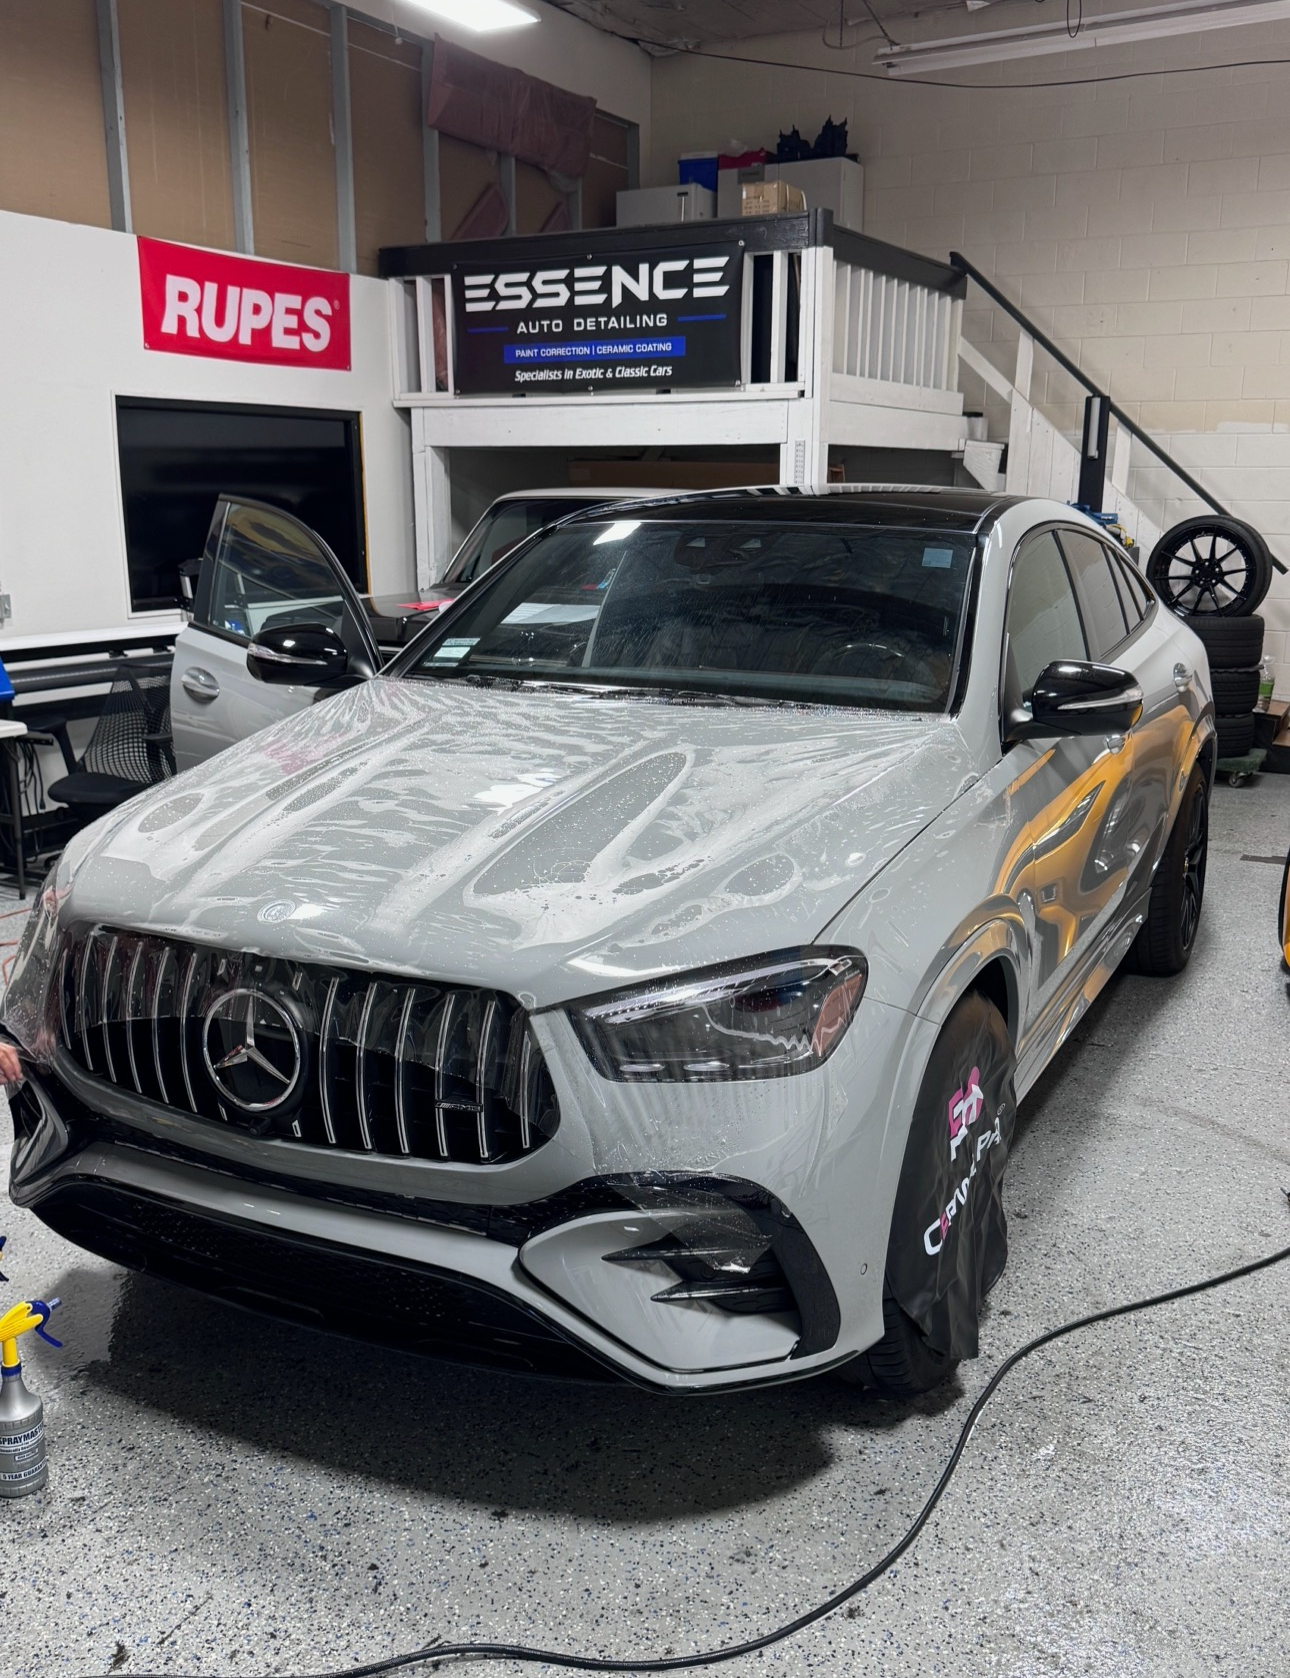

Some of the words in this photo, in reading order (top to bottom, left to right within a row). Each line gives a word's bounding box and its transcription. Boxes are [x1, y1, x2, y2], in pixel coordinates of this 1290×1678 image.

[464, 256, 730, 312] ESSENCE
[161, 274, 333, 352] RUPES
[516, 319, 564, 335] AUTO
[573, 313, 668, 332] DETAILING
[515, 348, 538, 358] PAINT
[540, 346, 591, 357] CORRECTION
[596, 343, 634, 355] CERAMIC
[635, 342, 672, 353] COATING
[514, 369, 563, 383] Specialists
[575, 366, 604, 379] Exotic
[605, 369, 613, 378] &
[615, 364, 648, 377] Classic
[650, 364, 673, 377] Cars
[7, 1472, 23, 1480] YEAR
